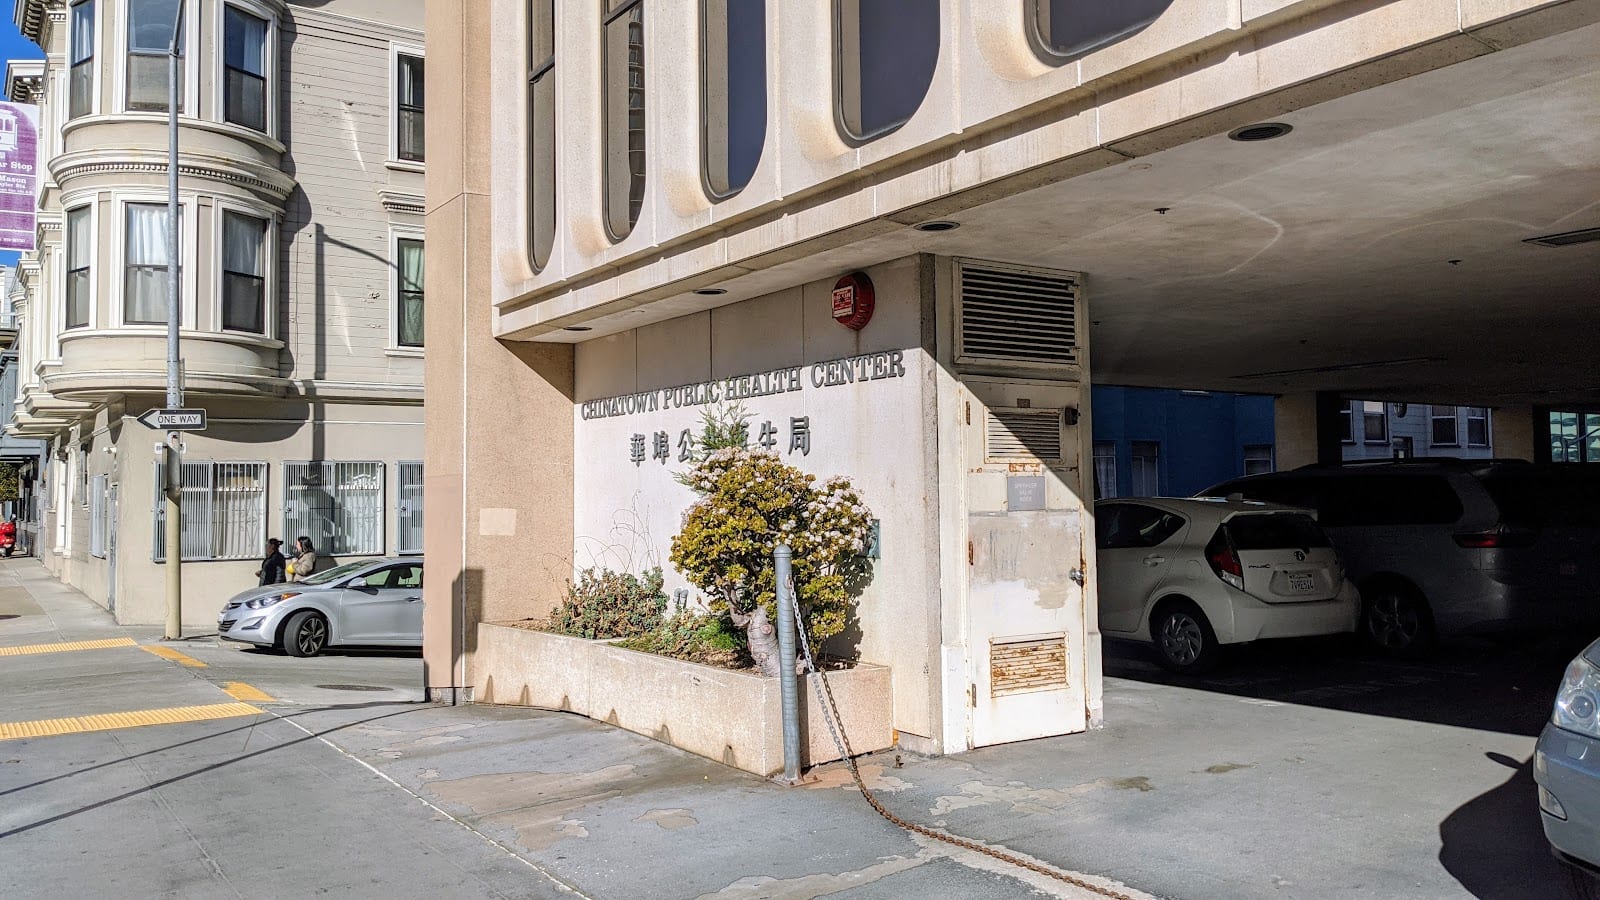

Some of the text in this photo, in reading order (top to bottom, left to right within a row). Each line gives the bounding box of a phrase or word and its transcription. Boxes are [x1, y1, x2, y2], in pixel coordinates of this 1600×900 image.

[11, 161, 33, 171] Stop
[581, 350, 906, 421] CHINATOWN PUBLIC HEALTH CENTER
[158, 415, 198, 424] ONE WAY
[629, 415, 811, 468] 華埠公生局
